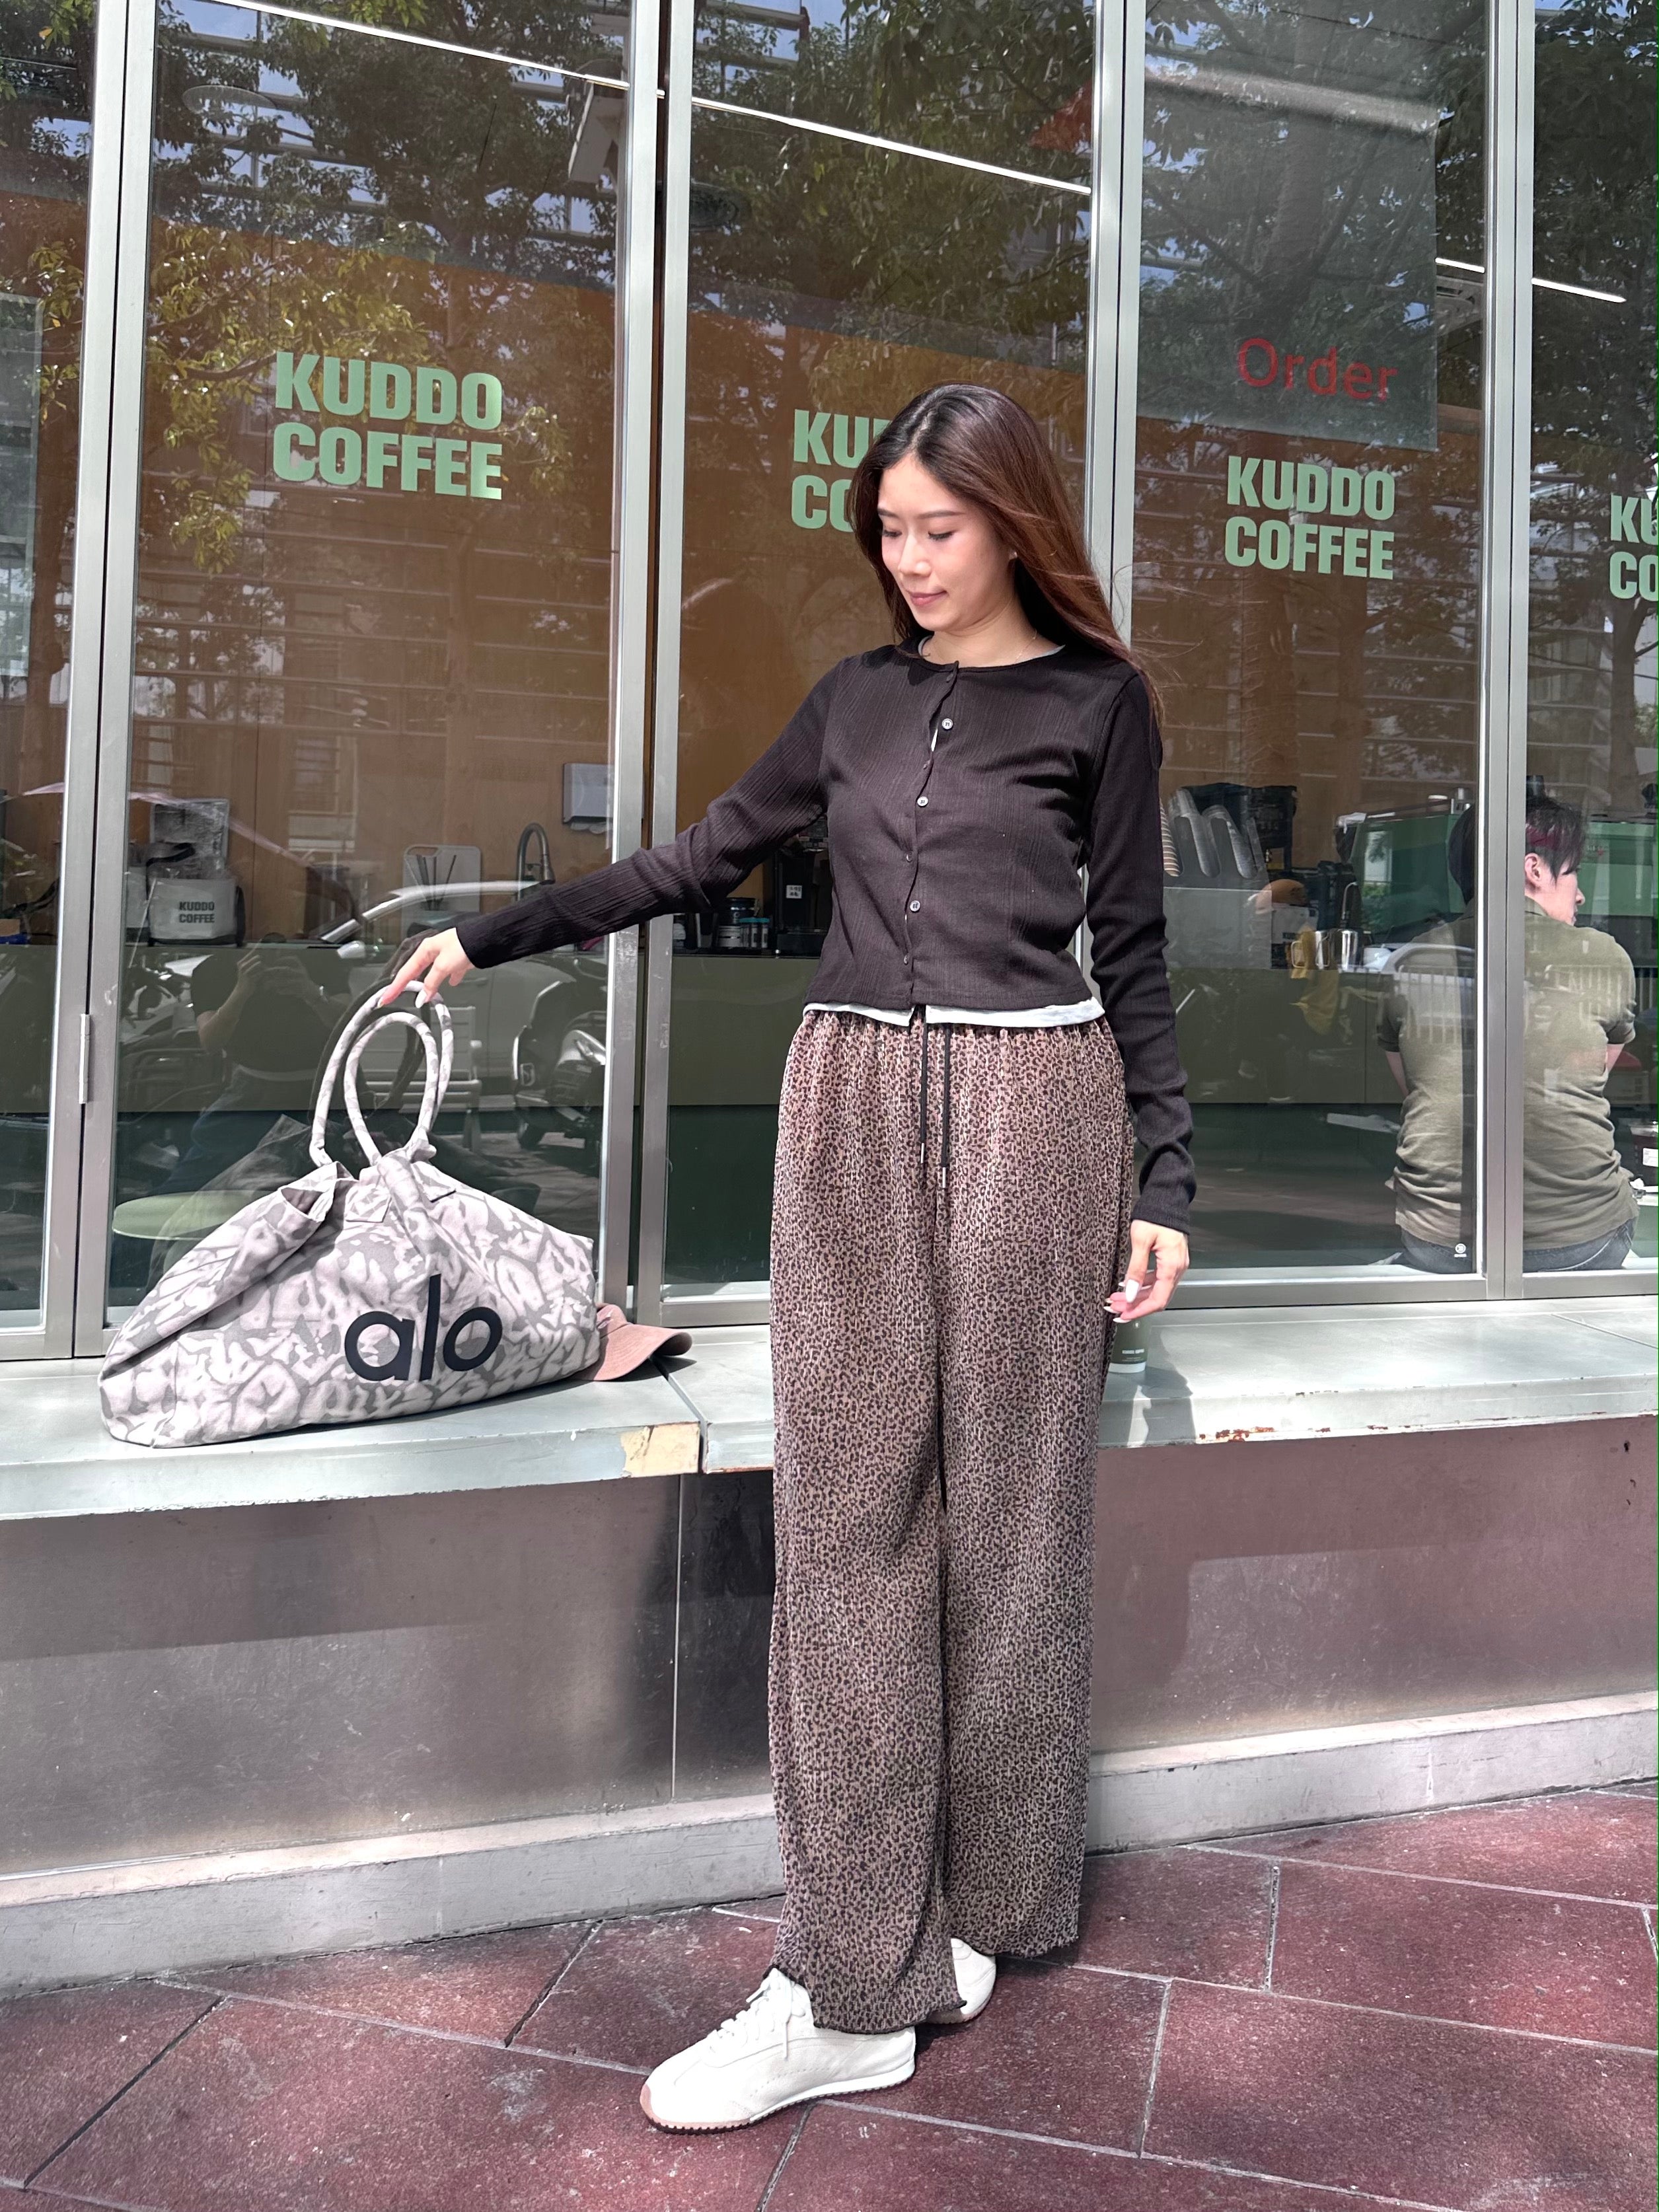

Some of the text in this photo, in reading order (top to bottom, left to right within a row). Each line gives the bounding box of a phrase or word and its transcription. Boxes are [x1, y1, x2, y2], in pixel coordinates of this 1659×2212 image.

[275, 351, 502, 430] KUDDO
[1237, 337, 1398, 401] Order
[274, 422, 503, 500] COFFEE
[1227, 455, 1395, 521] KUDDO
[1225, 516, 1395, 580] COFFEE
[179, 901, 215, 911] KUDDO
[179, 914, 215, 924] COFFEE
[344, 1273, 503, 1382] alo
